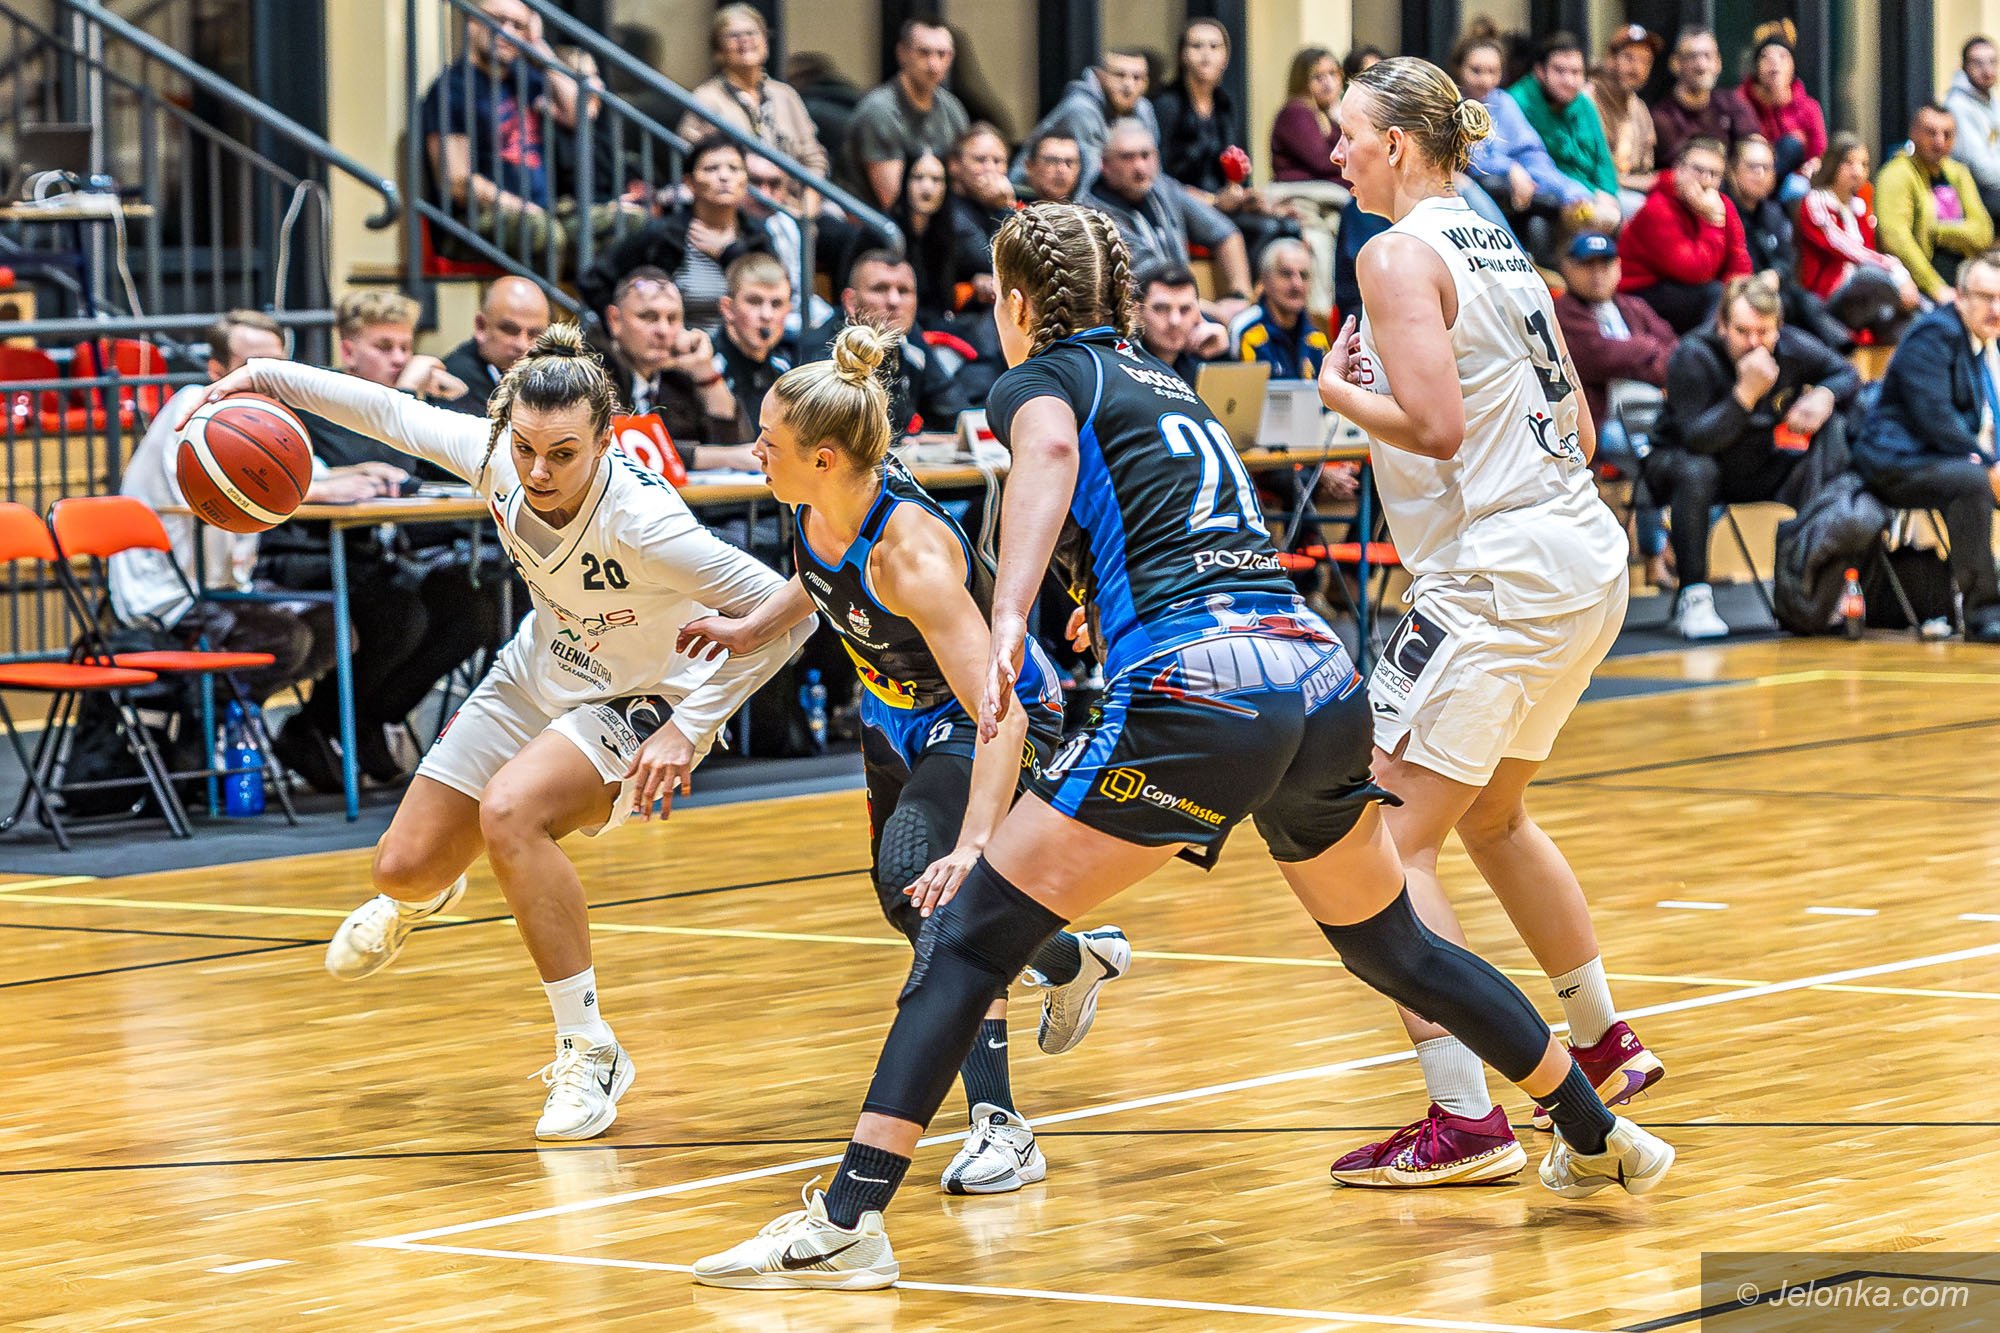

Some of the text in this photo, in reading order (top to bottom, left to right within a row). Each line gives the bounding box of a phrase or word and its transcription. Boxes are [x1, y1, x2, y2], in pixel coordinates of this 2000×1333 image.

[1441, 227, 1513, 250] WICHO
[580, 552, 630, 591] 20
[809, 571, 832, 596] PROTON
[1142, 785, 1226, 825] CopyMaster
